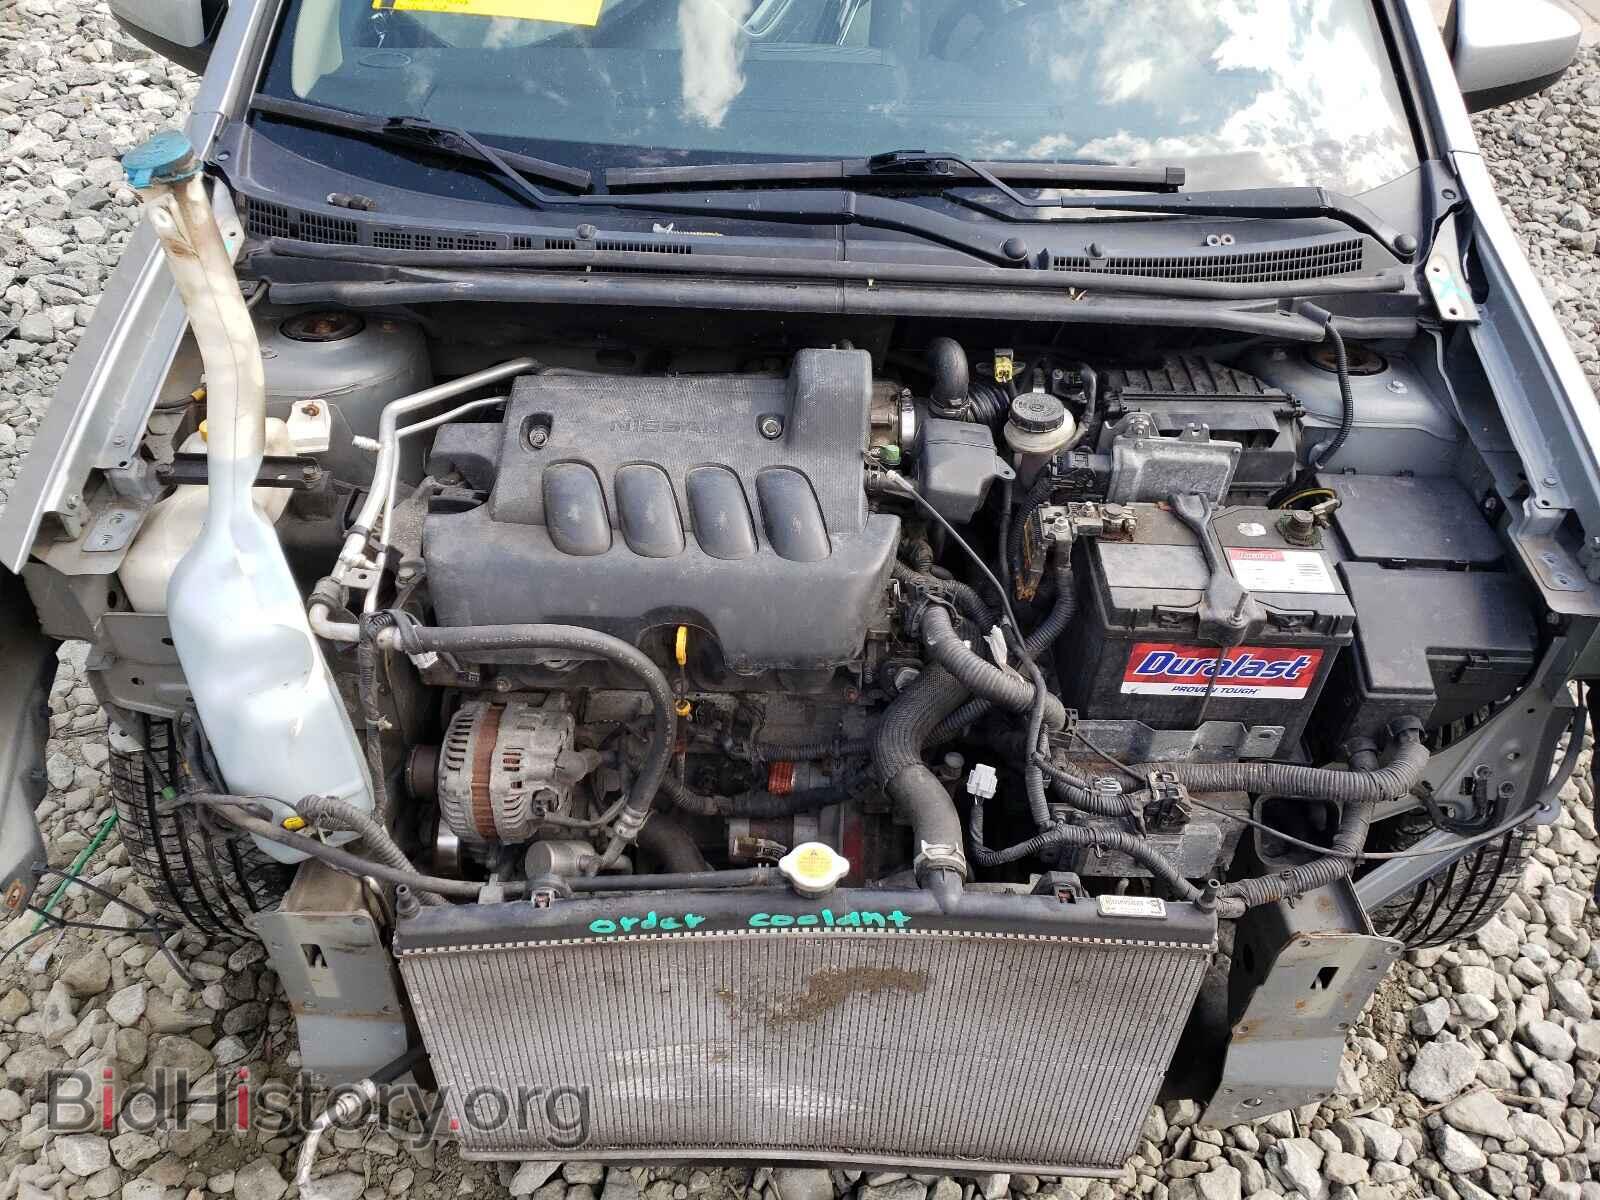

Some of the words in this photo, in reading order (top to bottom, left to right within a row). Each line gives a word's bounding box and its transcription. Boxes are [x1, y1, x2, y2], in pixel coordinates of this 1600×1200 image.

[1133, 650, 1311, 679] Duralast
[1219, 687, 1258, 695] TOUGH
[589, 911, 706, 933] order
[748, 908, 912, 928] coolant
